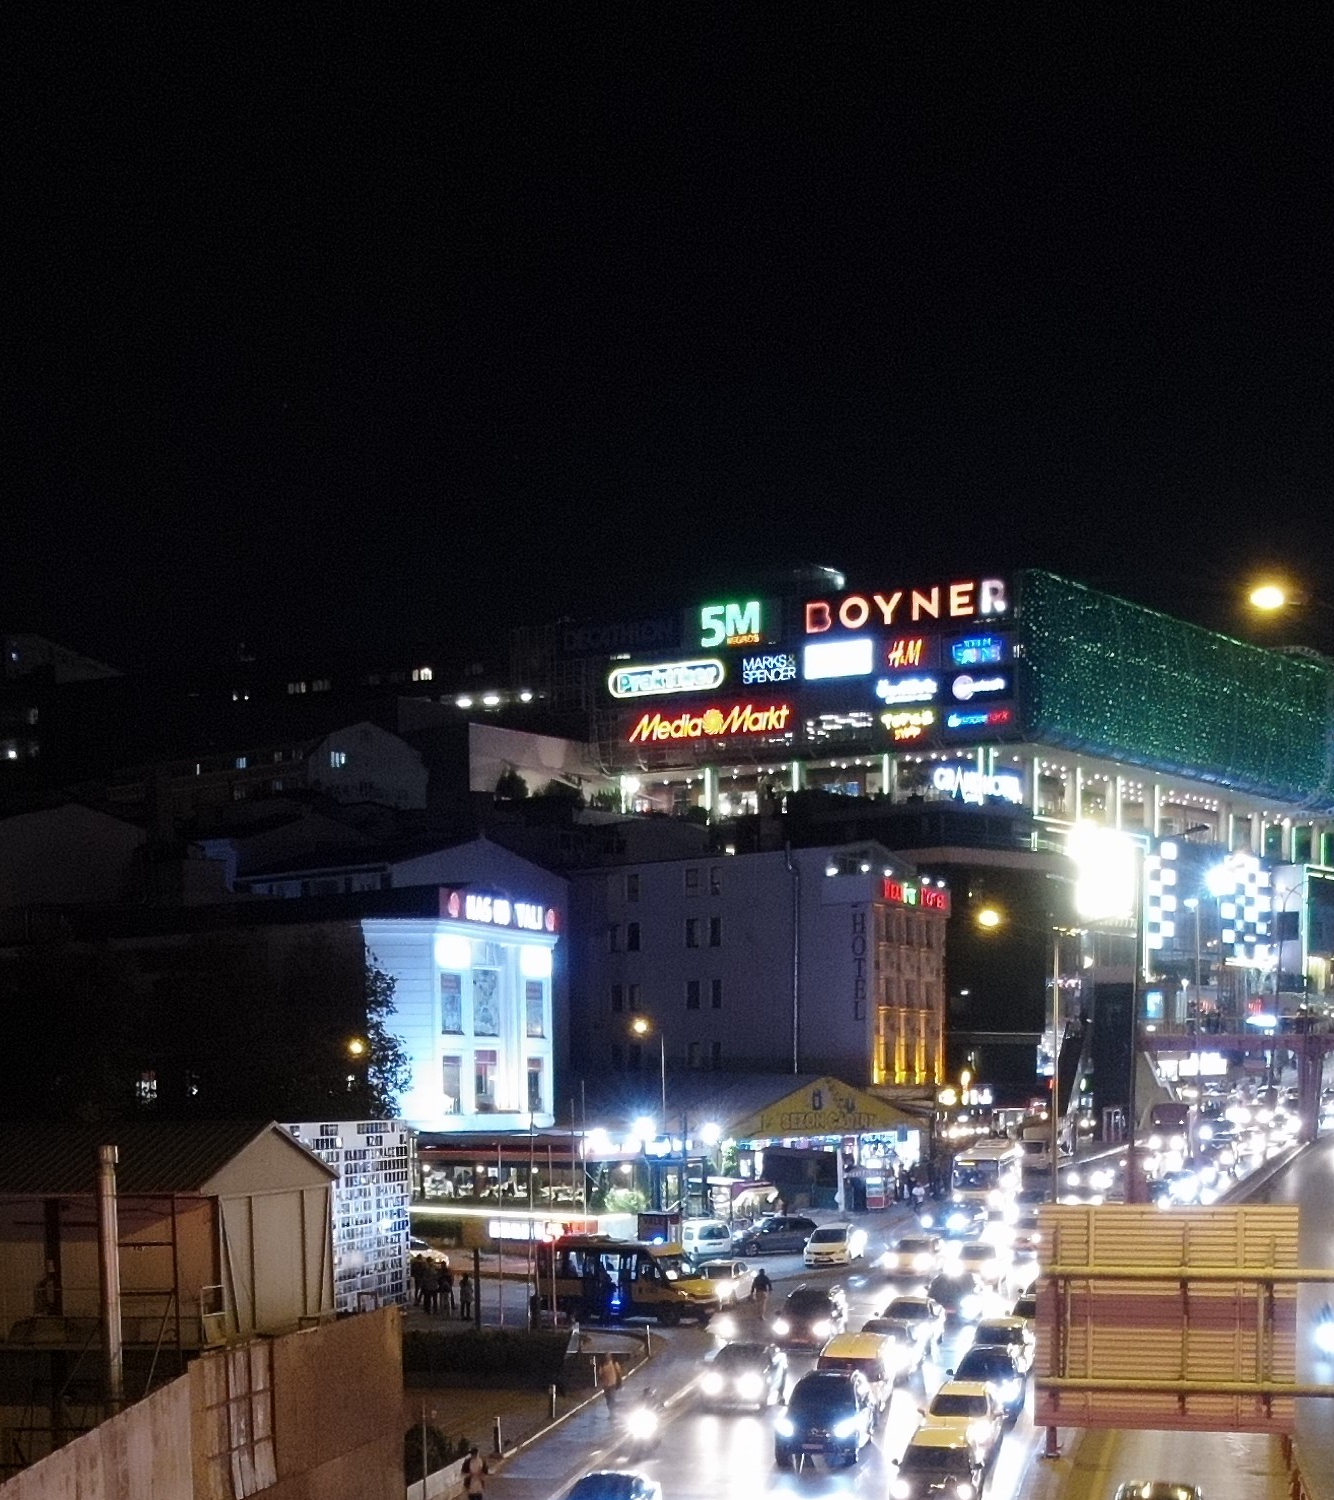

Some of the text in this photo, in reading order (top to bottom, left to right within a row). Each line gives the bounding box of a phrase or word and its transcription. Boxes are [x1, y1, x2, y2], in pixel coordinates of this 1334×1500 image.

[701, 601, 760, 648] 5M
[806, 579, 1006, 635] BOYNER
[743, 666, 796, 685] SPENCER
[888, 639, 922, 668] H&M
[851, 912, 867, 1021] HOTEL
